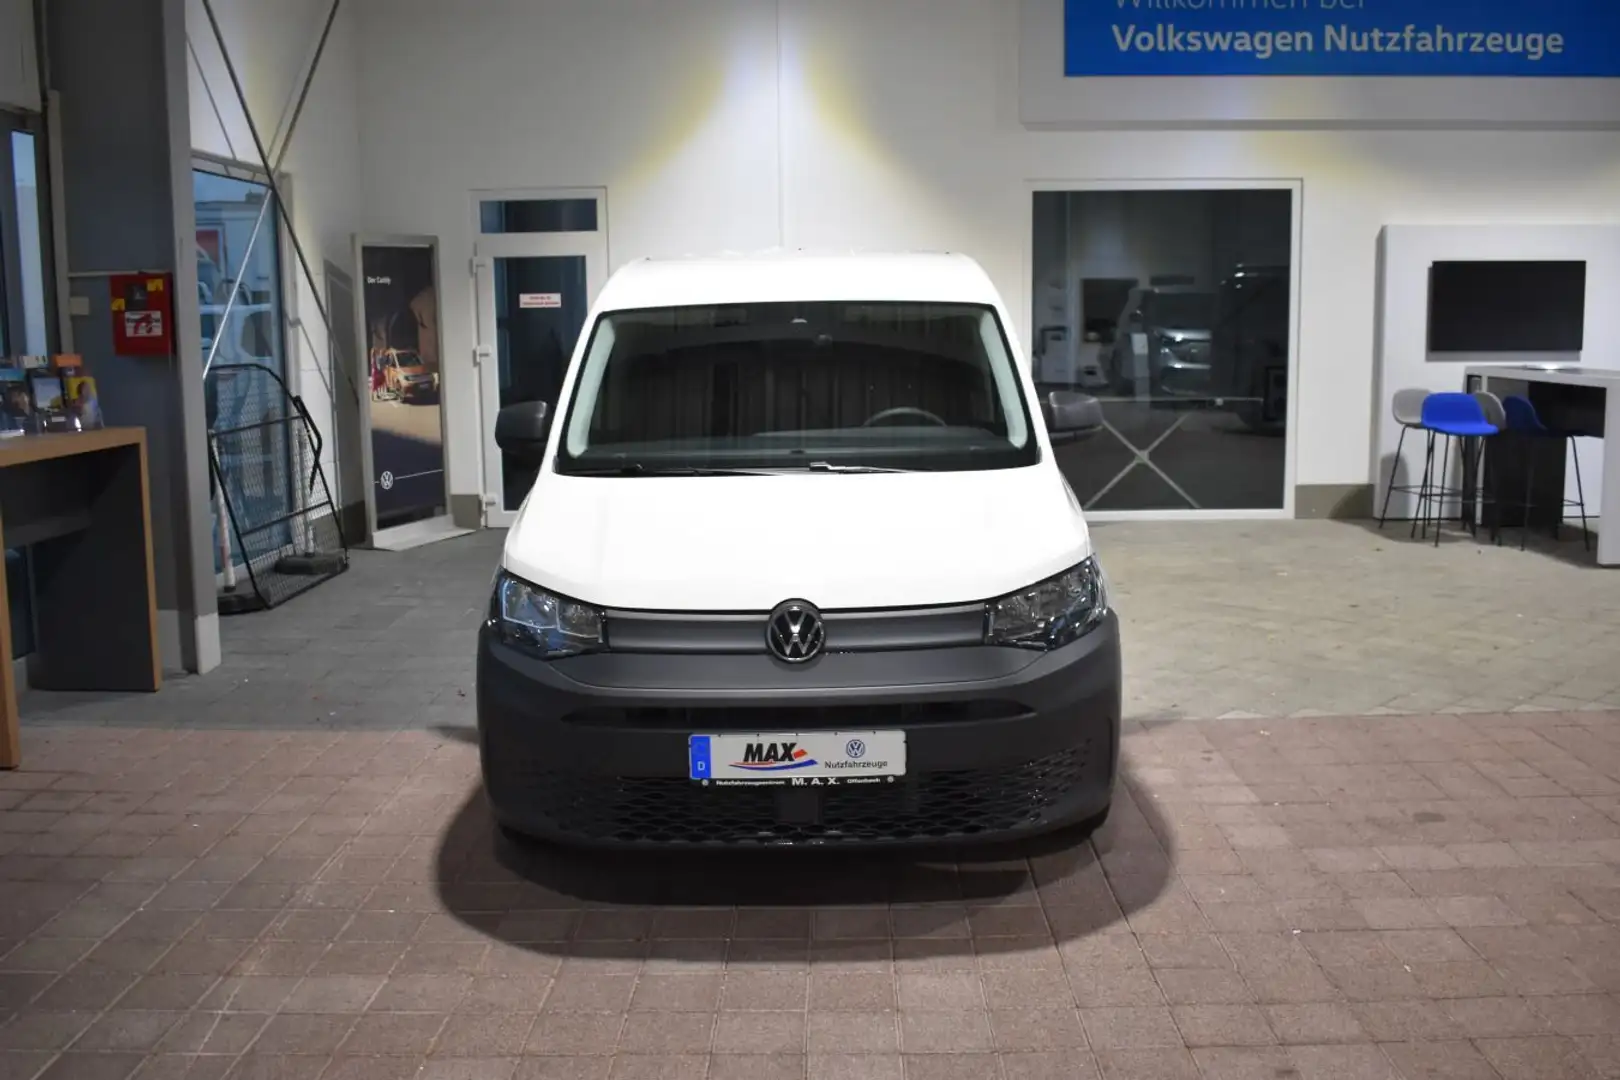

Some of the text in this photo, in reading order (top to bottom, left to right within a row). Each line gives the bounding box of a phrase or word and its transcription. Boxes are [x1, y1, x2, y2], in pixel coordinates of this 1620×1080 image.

[1111, 23, 1564, 60] Volkswagen Nutzfahrzeuge
[743, 743, 797, 762] MAX
[697, 761, 706, 771] D
[824, 760, 888, 769] Nutzfahrzeuge
[791, 777, 808, 786] M.
[811, 777, 824, 785] A.
[827, 777, 840, 785] X.
